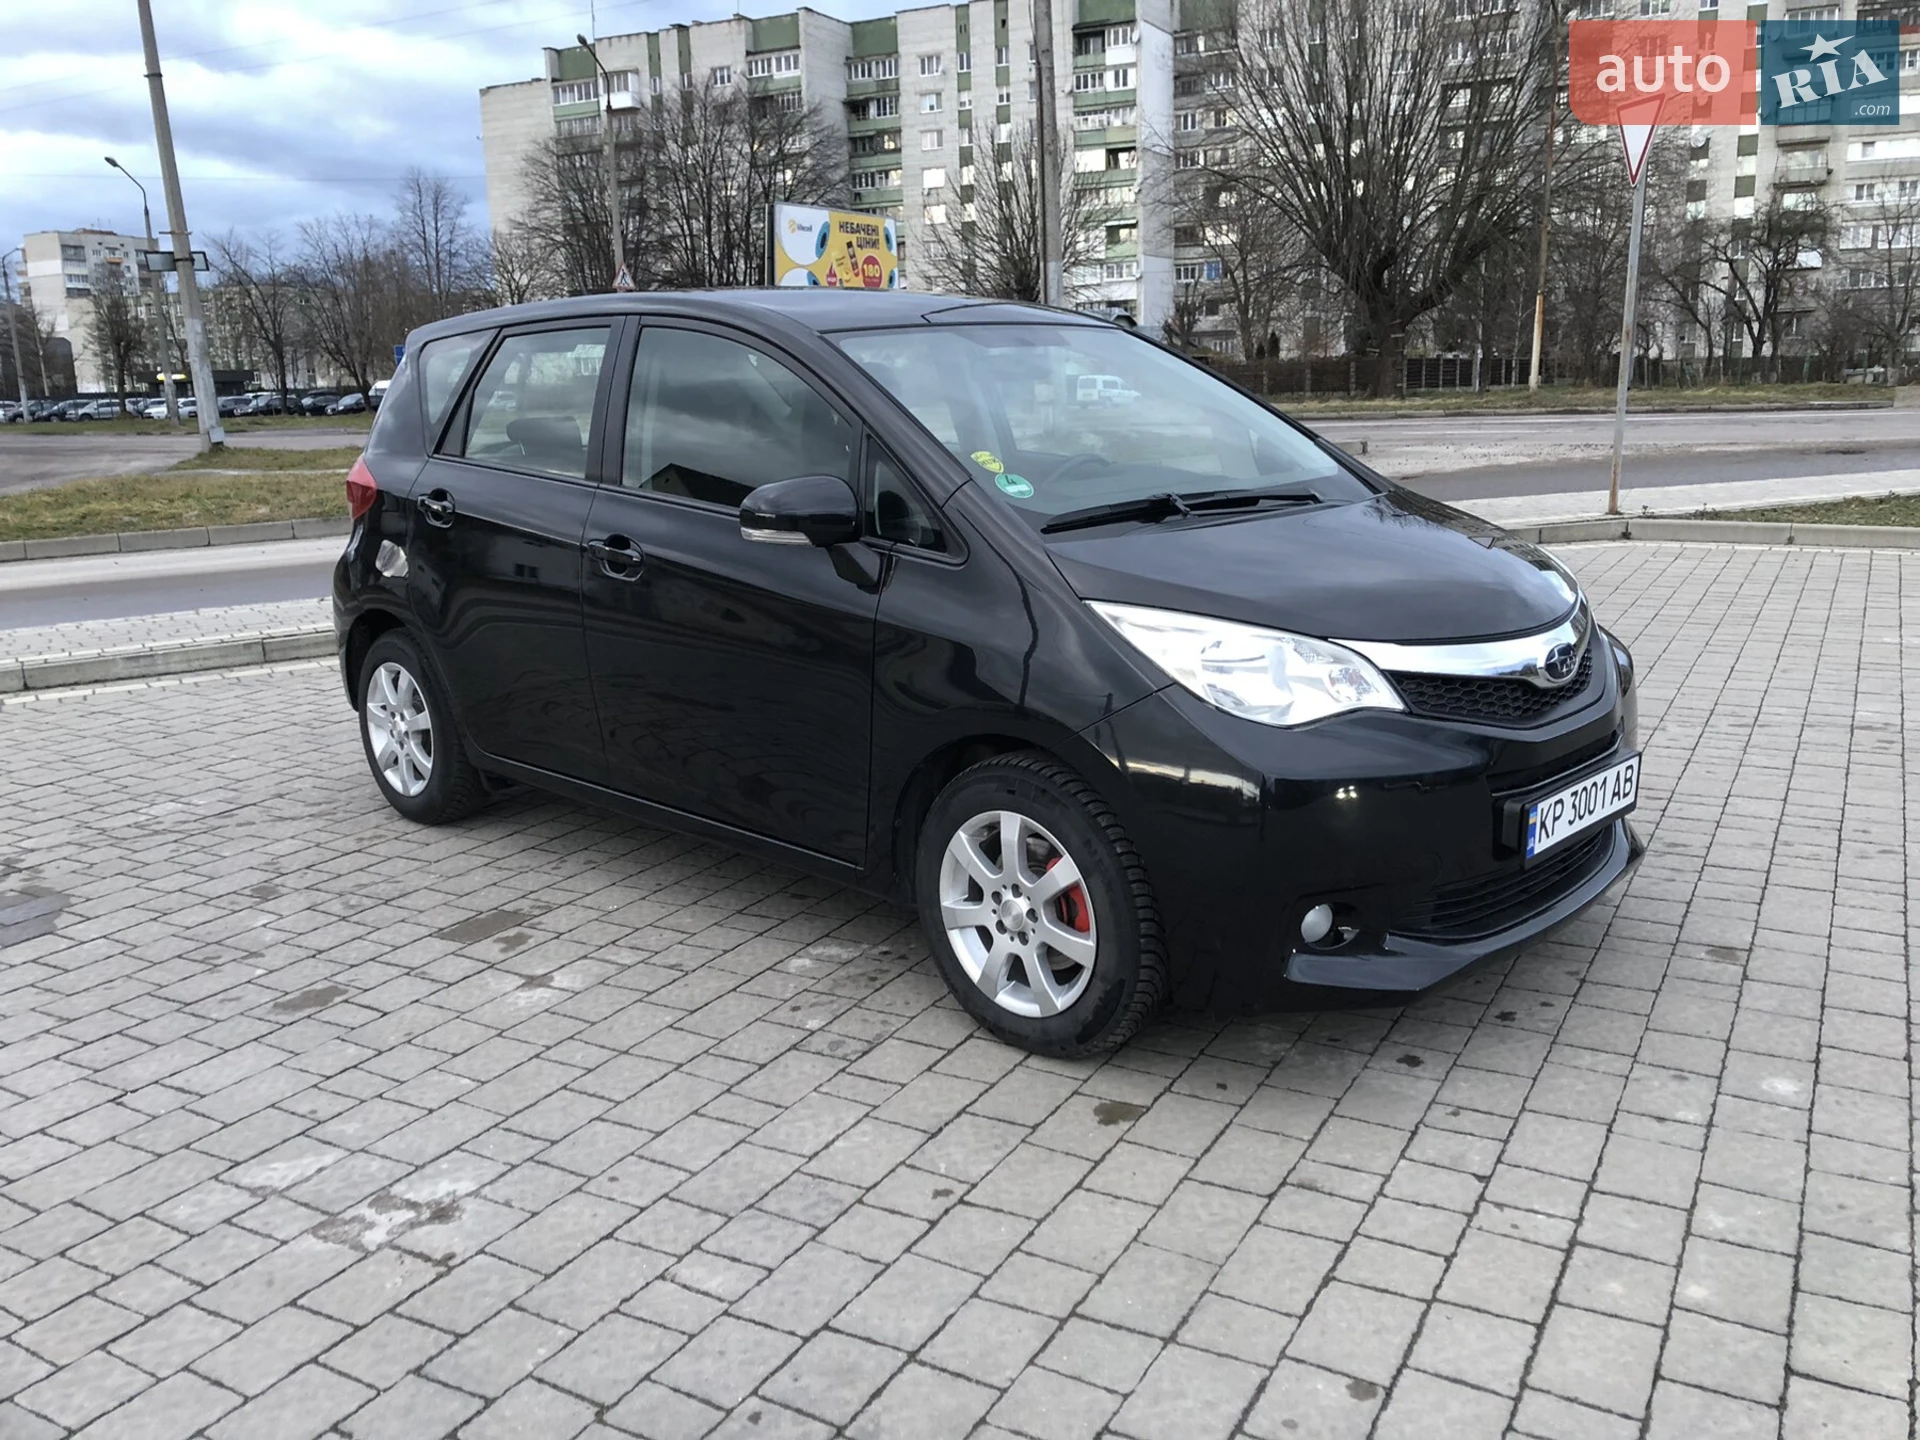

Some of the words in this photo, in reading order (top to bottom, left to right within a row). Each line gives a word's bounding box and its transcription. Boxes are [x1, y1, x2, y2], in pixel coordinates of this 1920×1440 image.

[839, 221, 880, 236] НЕБАЧЕНІ
[856, 237, 880, 250] ЦІНИ!
[864, 264, 880, 277] 180
[1005, 475, 1017, 485] 4
[1538, 798, 1565, 844] KP
[1568, 776, 1607, 826] 3001
[1610, 764, 1634, 806] AB
